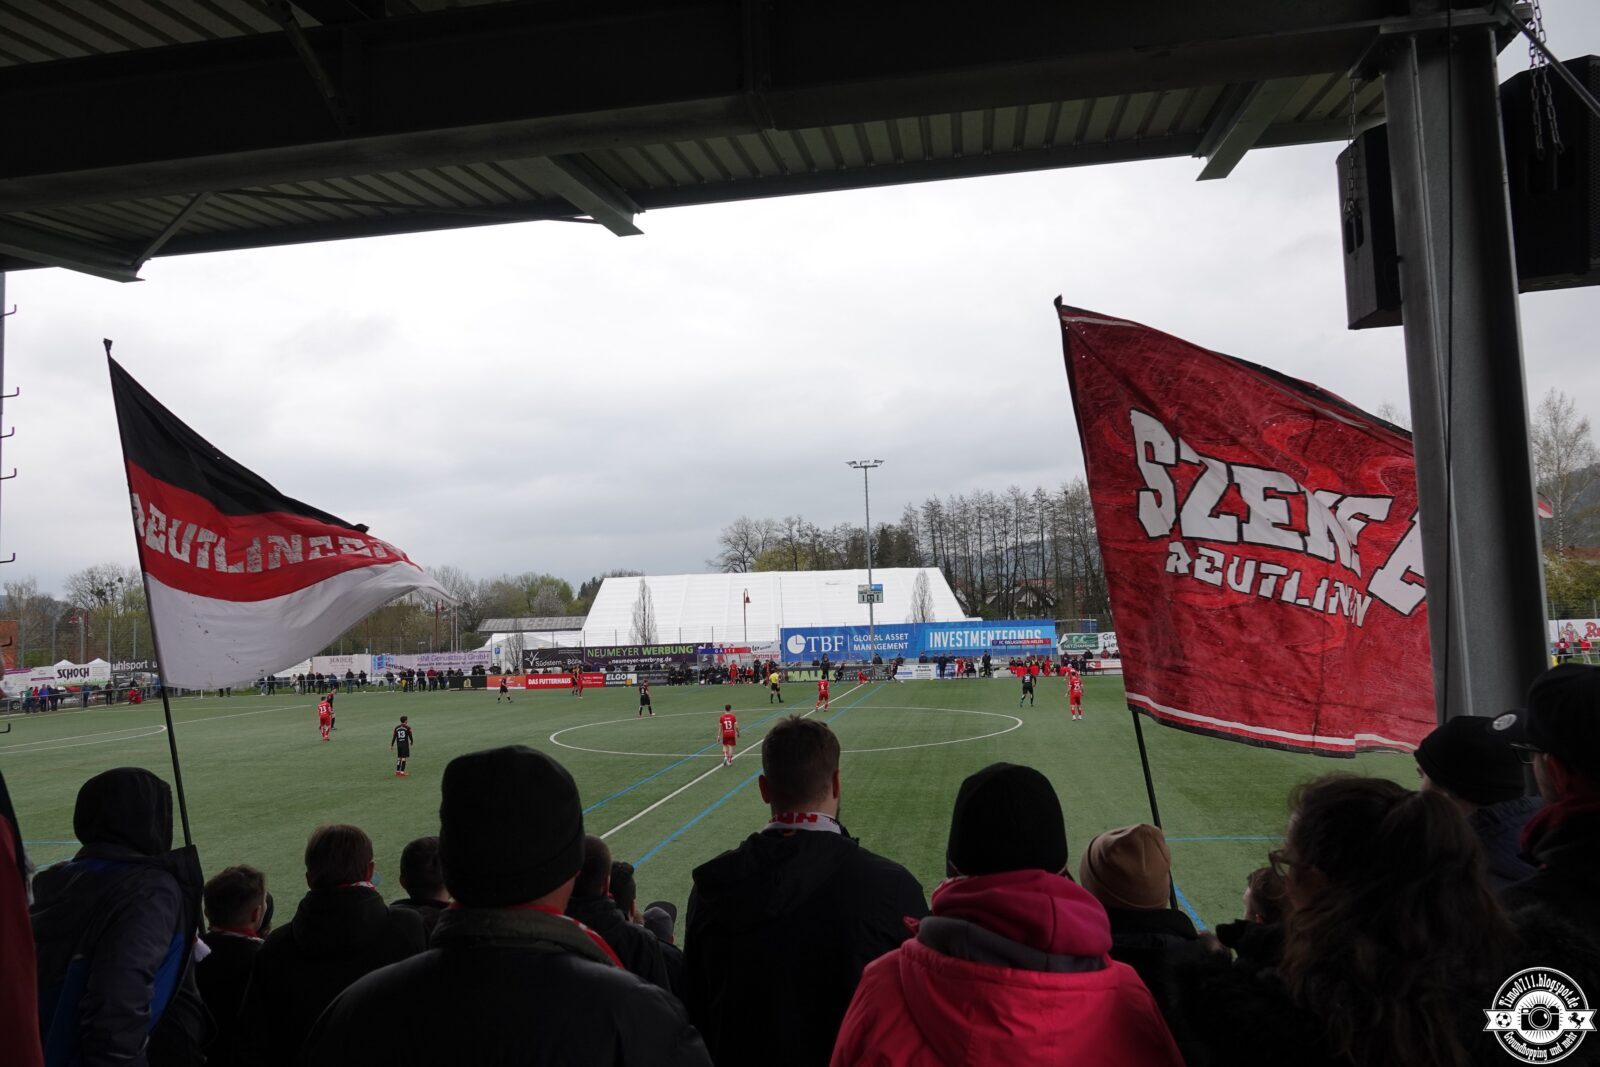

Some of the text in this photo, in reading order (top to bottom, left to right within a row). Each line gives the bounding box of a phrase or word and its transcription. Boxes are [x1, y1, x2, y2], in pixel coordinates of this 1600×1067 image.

[885, 632, 909, 641] ASSET
[929, 629, 1042, 648] INVESTMENTFONDS
[806, 635, 844, 653] TBF
[587, 648, 639, 658] NEUMEYER
[641, 645, 694, 656] WERBUNG
[112, 660, 148, 671] uhlsport
[57, 667, 90, 679] SCHOCH
[605, 673, 627, 681] ELGO
[539, 677, 571, 685] FUTTERHAUS
[723, 721, 732, 729] 13
[397, 730, 406, 738] 13
